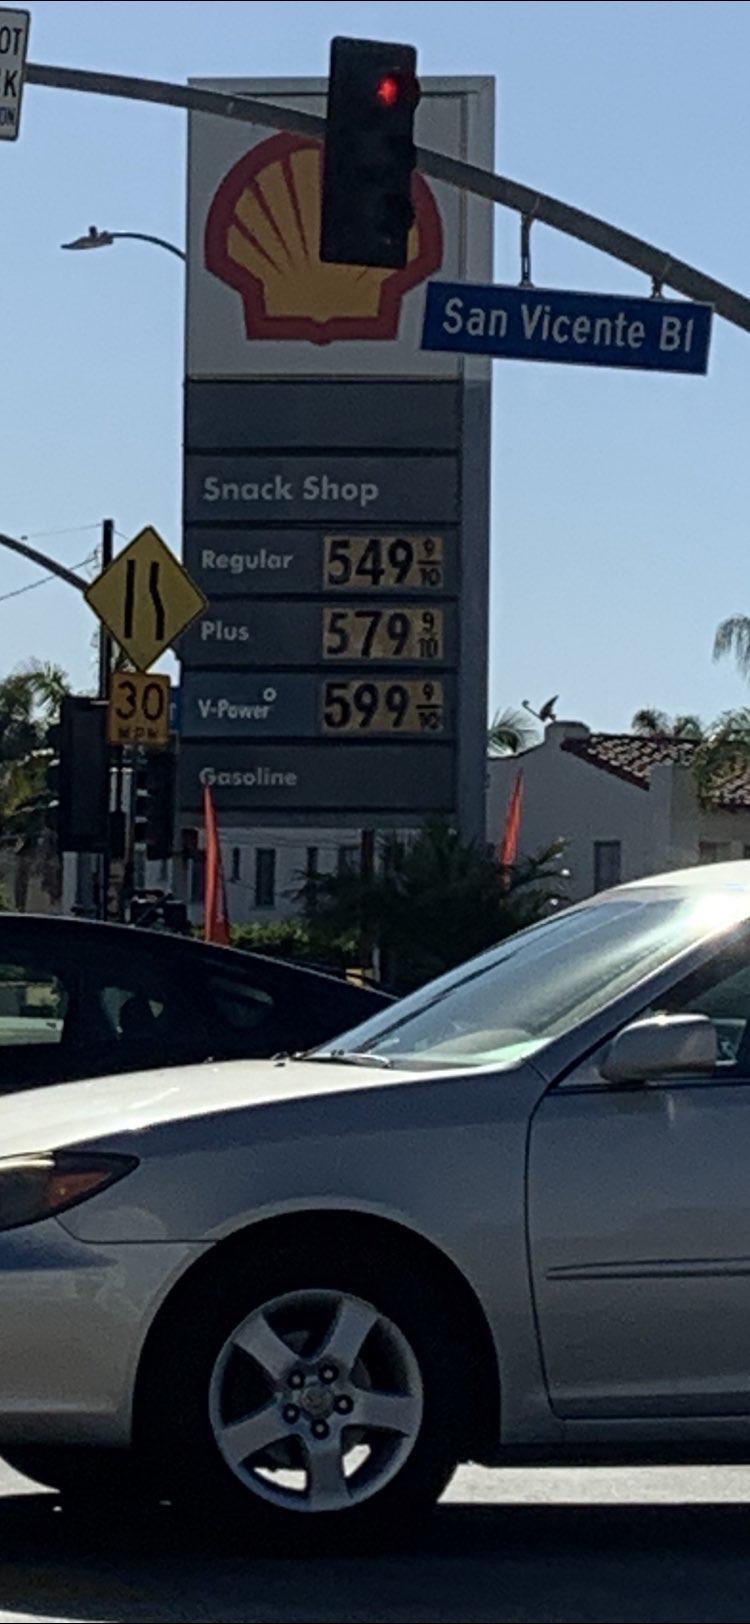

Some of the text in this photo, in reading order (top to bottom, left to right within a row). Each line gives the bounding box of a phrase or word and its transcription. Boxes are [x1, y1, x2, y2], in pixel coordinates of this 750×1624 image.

[443, 298, 508, 337] San
[521, 304, 646, 348] Vicente
[204, 475, 379, 506] Snack Shop
[202, 550, 293, 574] Regular
[327, 538, 414, 586] 549
[201, 621, 249, 641] Plus
[326, 611, 410, 658] 579
[115, 680, 164, 720] 30
[198, 699, 270, 719] V-Power
[323, 683, 409, 728] 599
[199, 767, 297, 787] Gasoline
